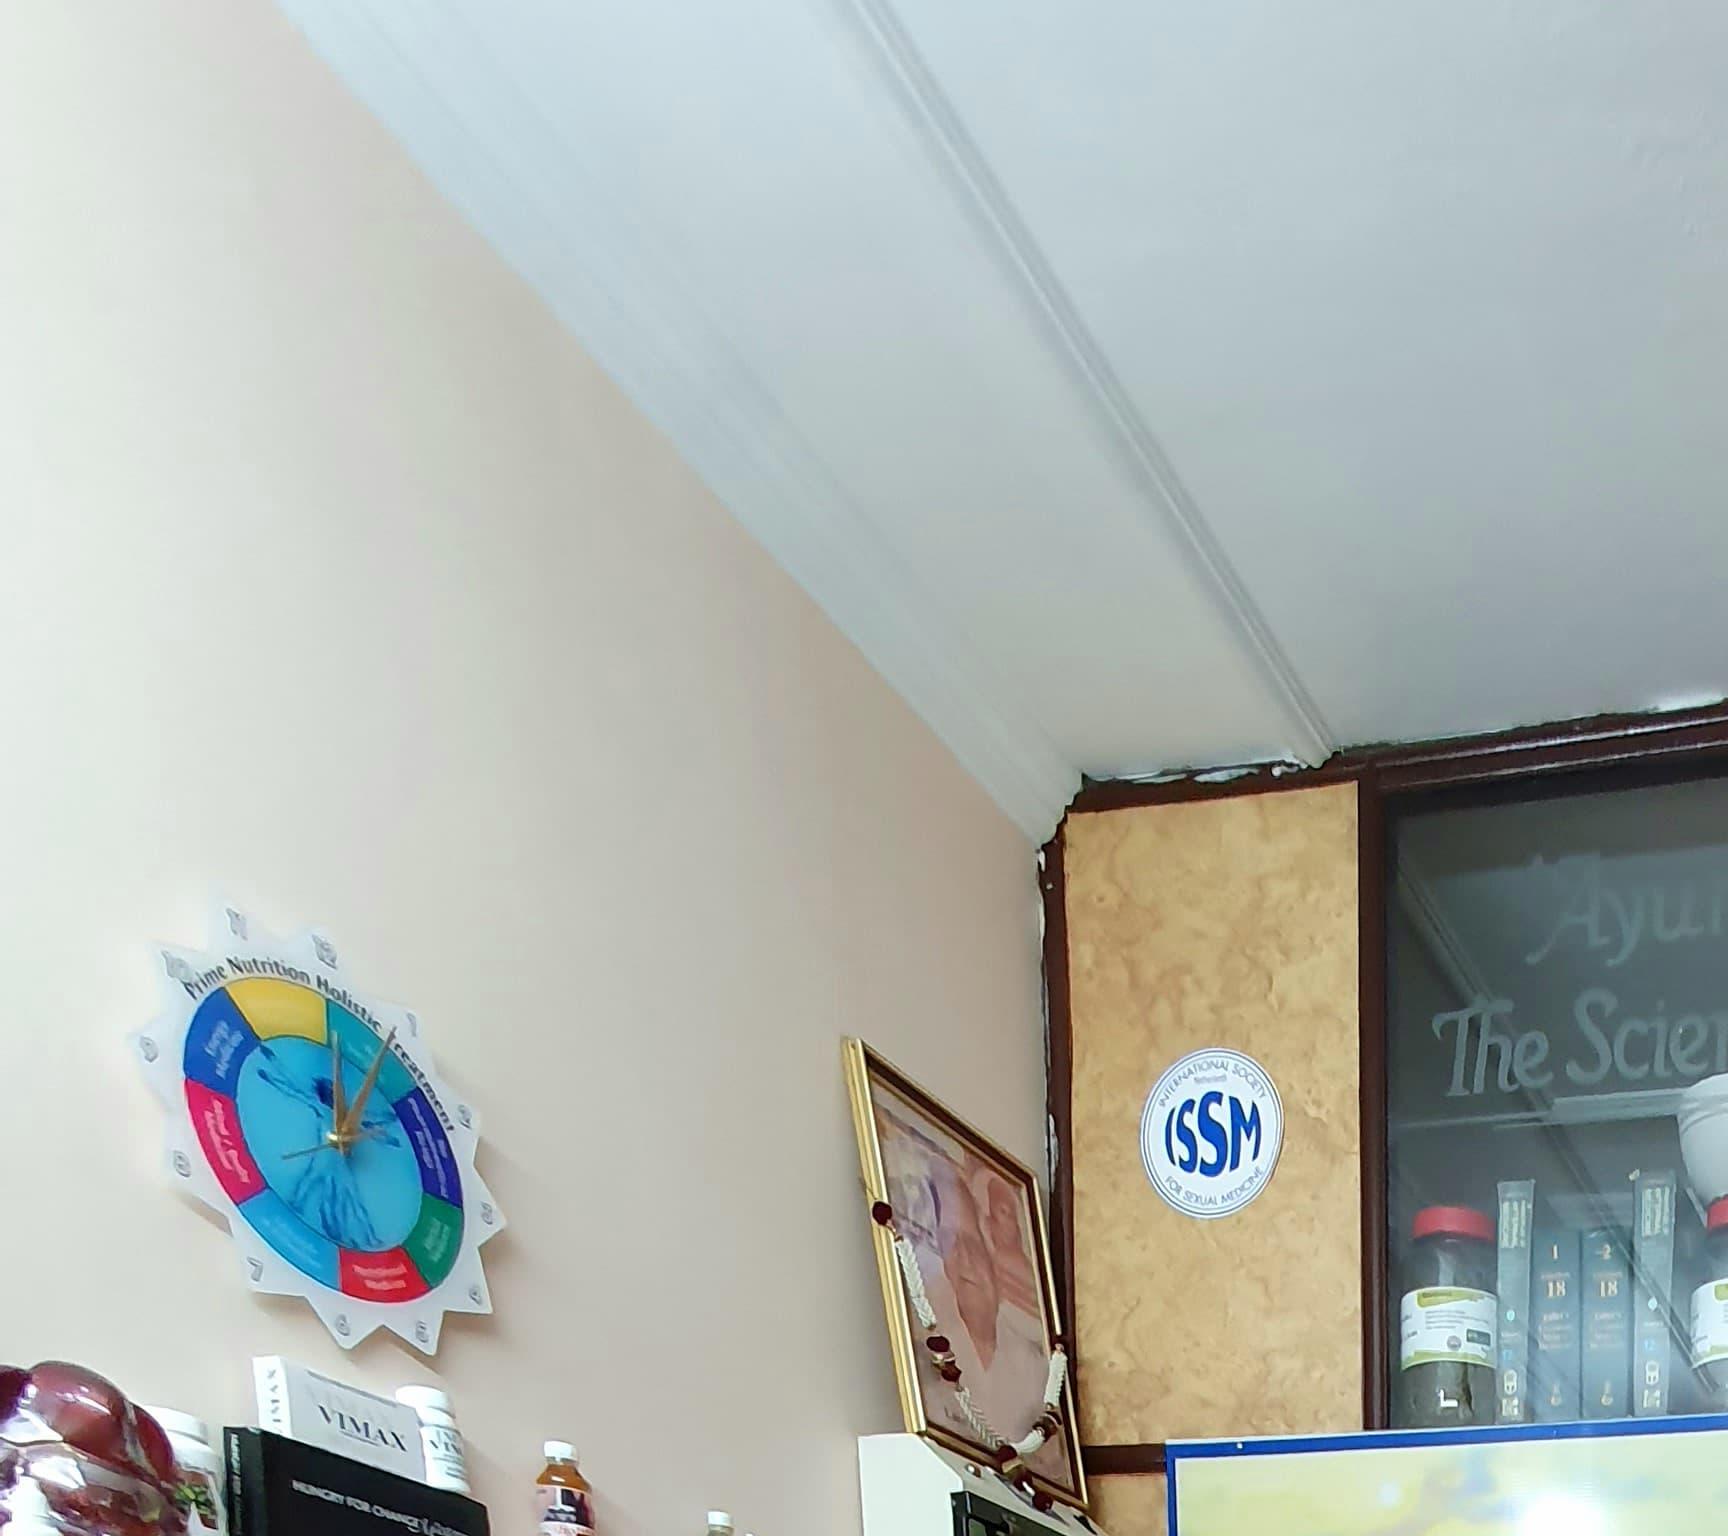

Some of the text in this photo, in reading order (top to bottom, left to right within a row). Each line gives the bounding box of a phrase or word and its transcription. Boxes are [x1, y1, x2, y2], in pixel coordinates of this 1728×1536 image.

[184, 957, 454, 1132] Prime Nutrition Holistic reatment
[1431, 999, 1552, 1097] The
[1158, 1060, 1267, 1107] INTERNATIONAL SOCIETY
[1165, 1091, 1262, 1177] ISSM
[1165, 1166, 1264, 1206] FOR SEXUAL MEDICINE
[317, 1403, 408, 1453] VIMAX
